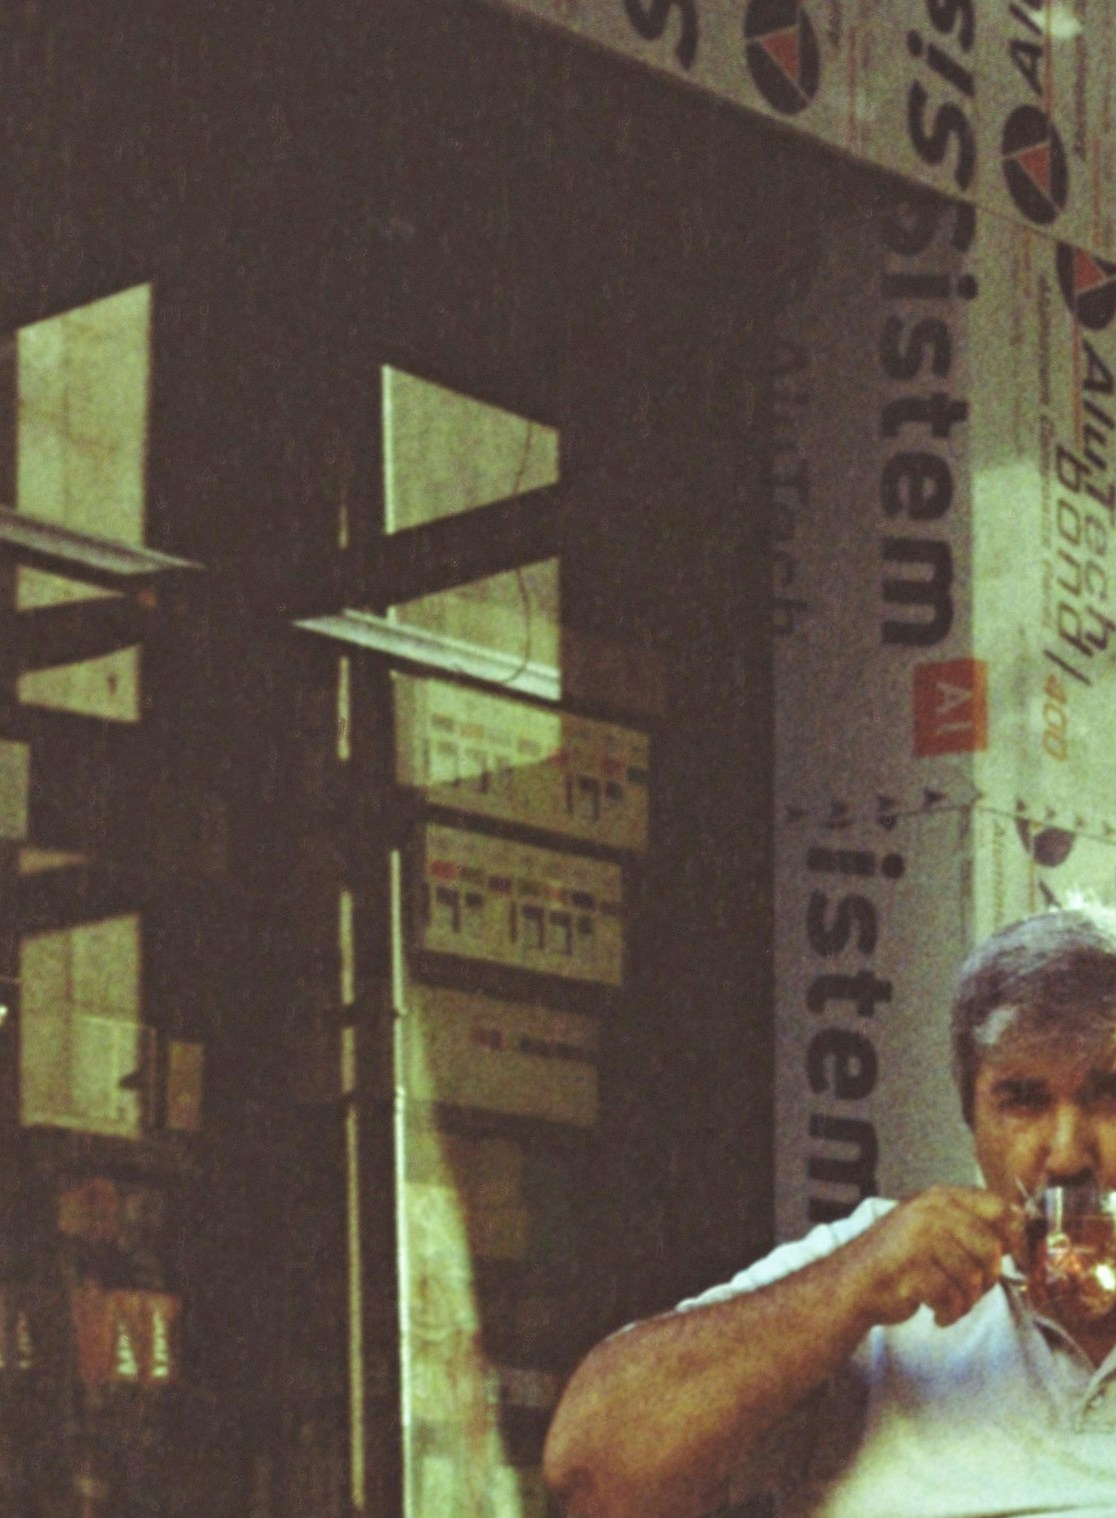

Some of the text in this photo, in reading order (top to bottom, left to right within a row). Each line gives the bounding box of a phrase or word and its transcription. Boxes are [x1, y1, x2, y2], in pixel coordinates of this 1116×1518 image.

[1007, 0, 1043, 97] Al
[880, 202, 978, 648] Sistem
[1042, 445, 1098, 763] bond 400
[806, 812, 907, 1222] istem
